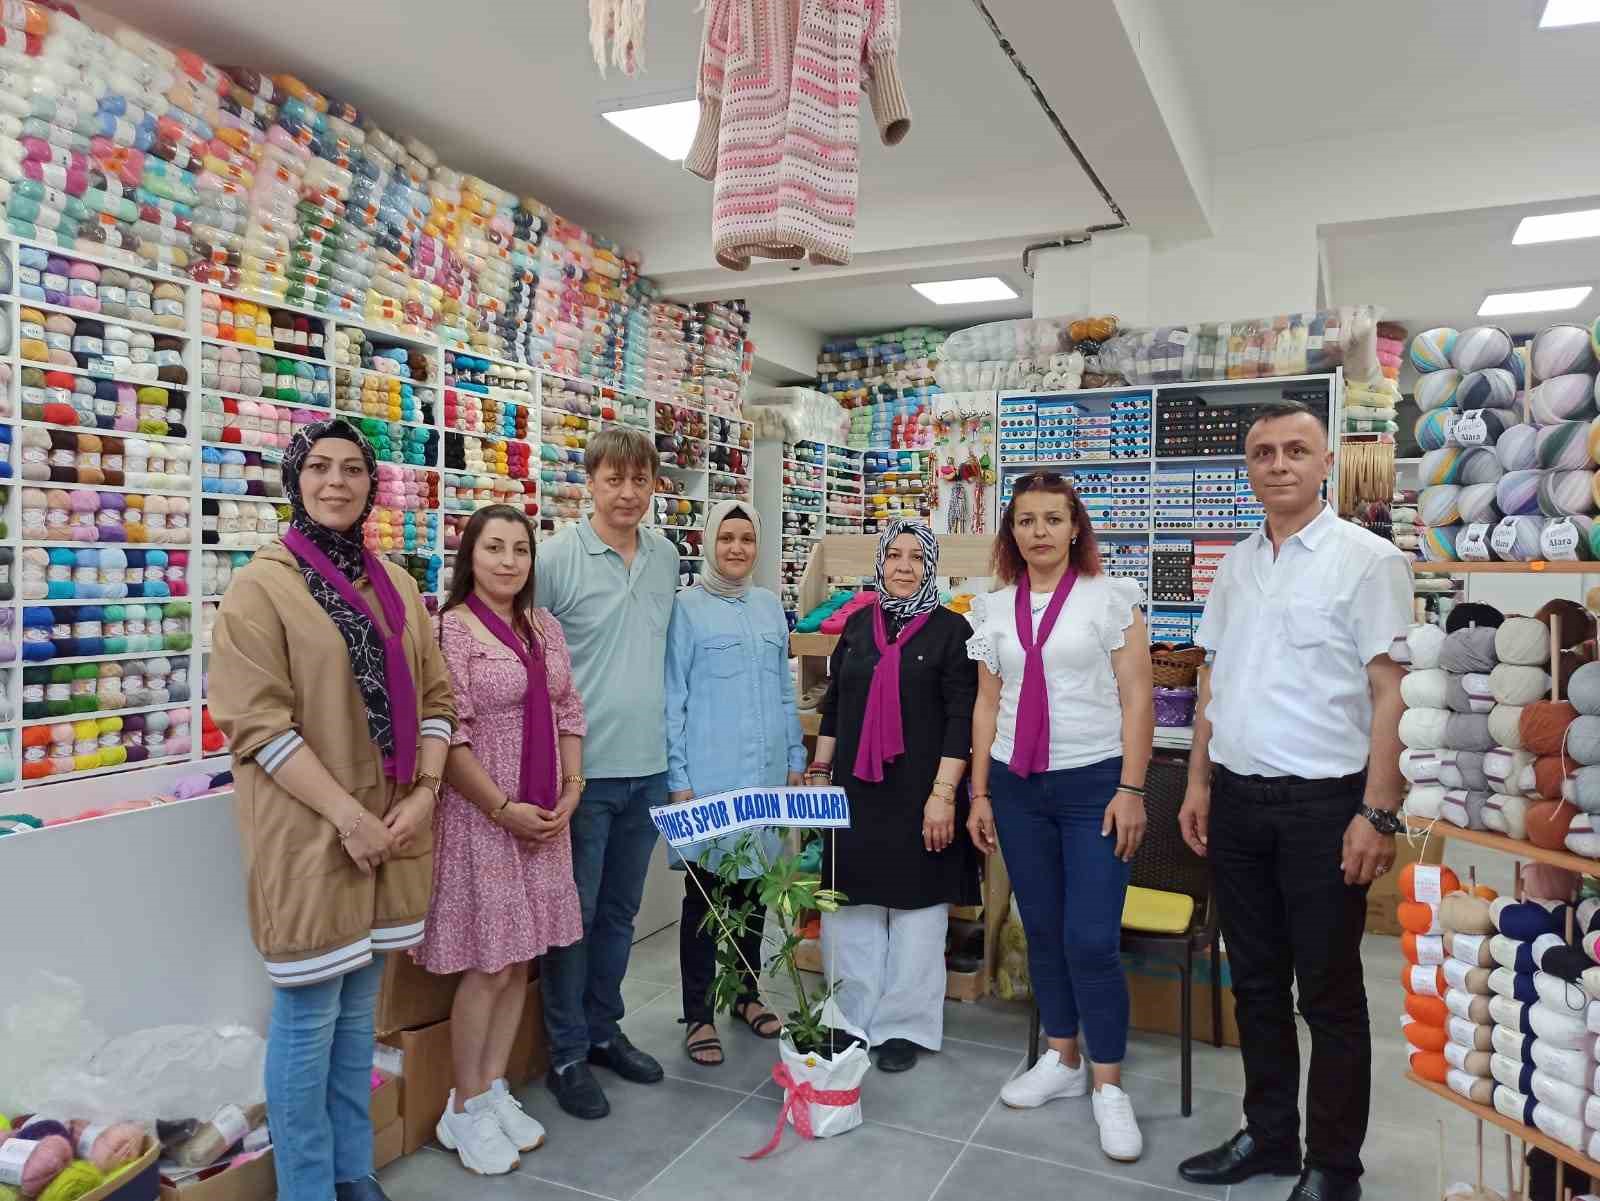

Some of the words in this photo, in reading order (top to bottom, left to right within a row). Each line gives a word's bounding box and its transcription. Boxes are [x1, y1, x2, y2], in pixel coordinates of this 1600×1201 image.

[1549, 537, 1572, 547] Alara
[691, 800, 731, 833] SPOR
[733, 793, 781, 822] KADIN
[786, 793, 847, 819] KOLLARI
